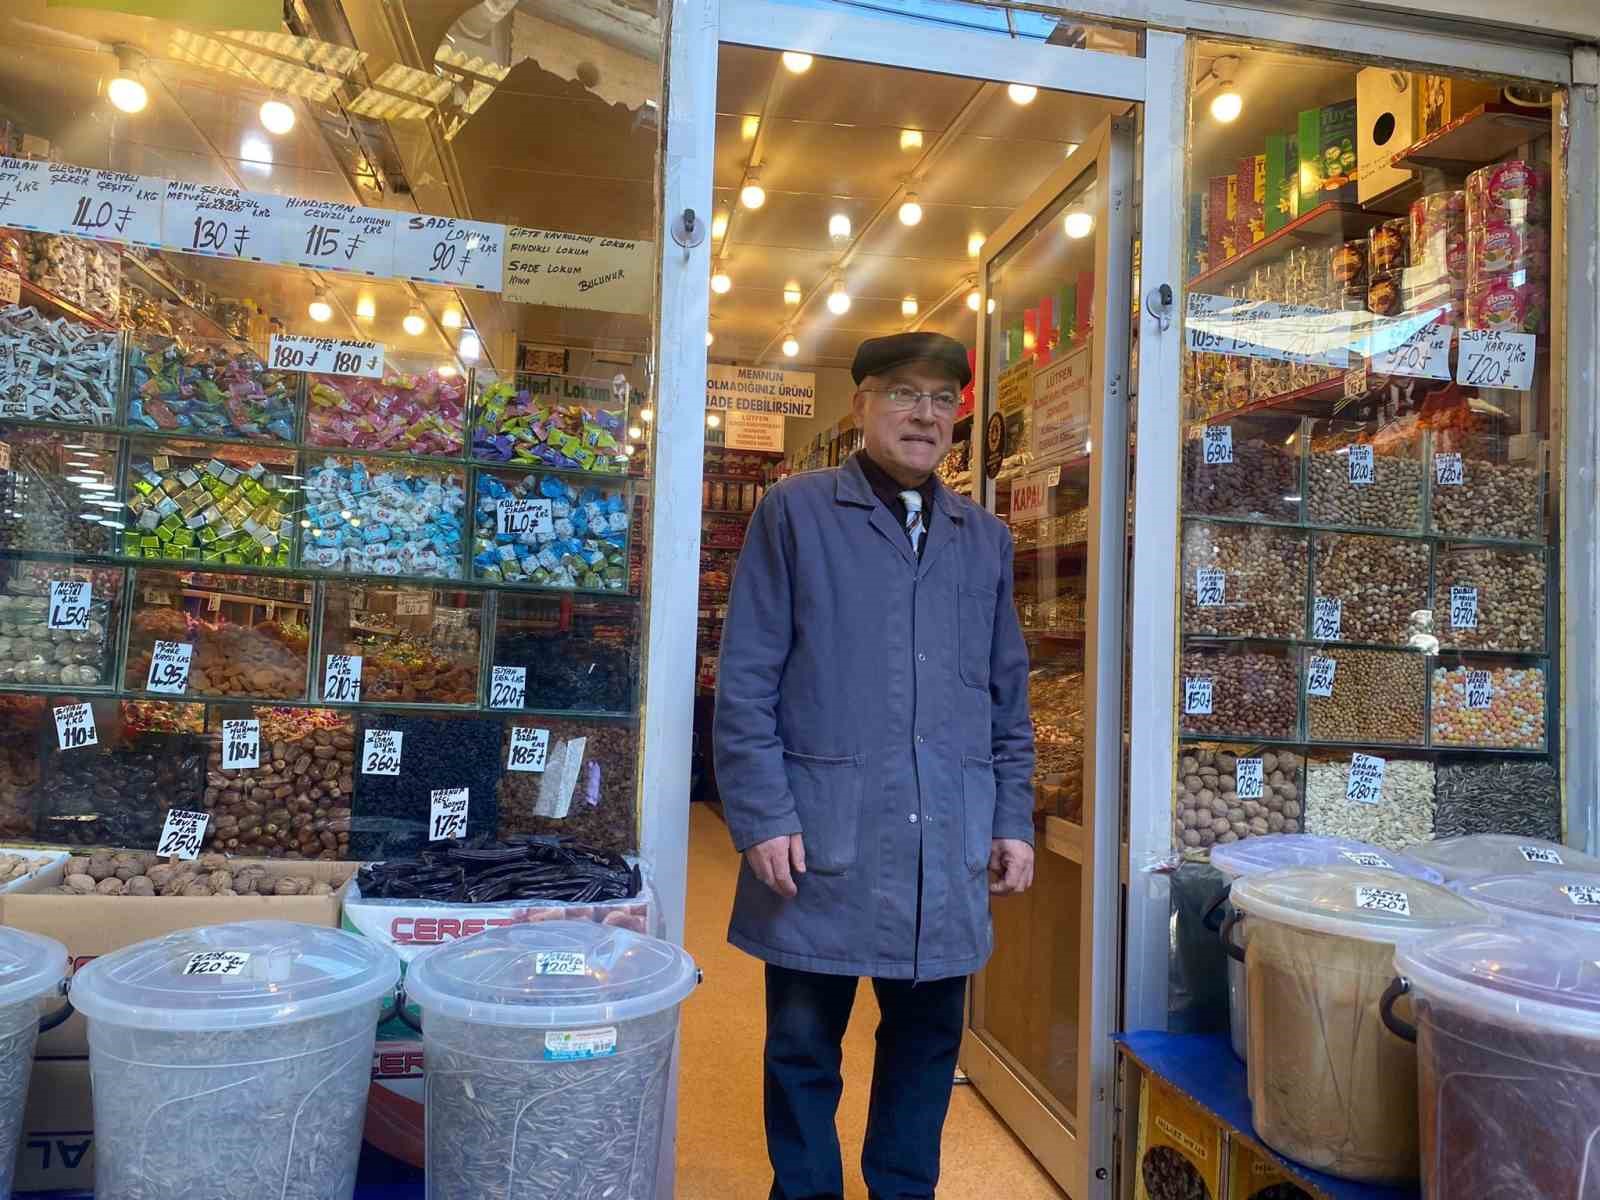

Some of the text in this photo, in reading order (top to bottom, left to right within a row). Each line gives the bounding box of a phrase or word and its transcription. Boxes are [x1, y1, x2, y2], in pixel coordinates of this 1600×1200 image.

[408, 217, 457, 230] SADE
[507, 260, 582, 275] SADE LOKUM
[737, 369, 784, 382] MEMNUN
